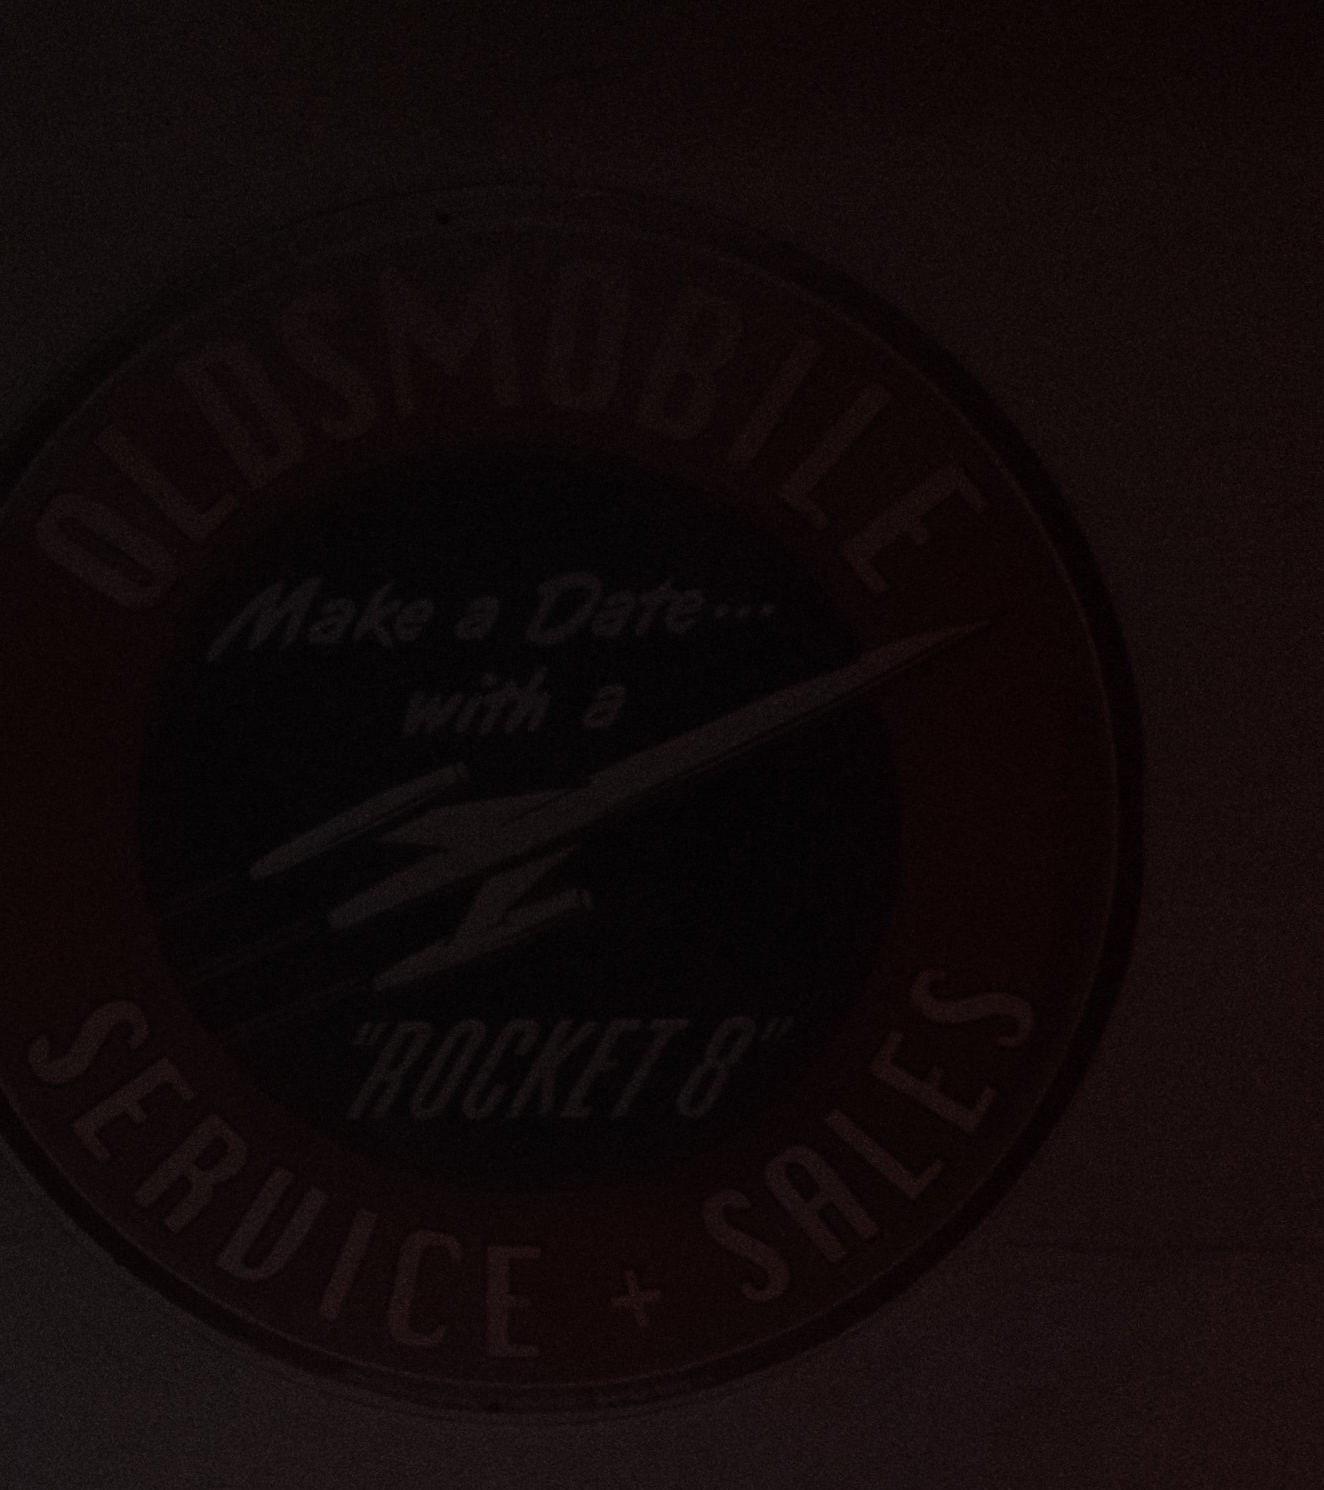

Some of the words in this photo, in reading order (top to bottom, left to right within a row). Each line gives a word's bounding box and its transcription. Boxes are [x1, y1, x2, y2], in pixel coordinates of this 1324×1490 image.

[35, 258, 988, 615] OLDSMOBILE
[206, 576, 435, 664] Make
[454, 591, 503, 640] a
[401, 668, 551, 738] with
[580, 680, 627, 731] a
[27, 1002, 543, 1360] SERVICE
[702, 966, 1035, 1303] SALES
